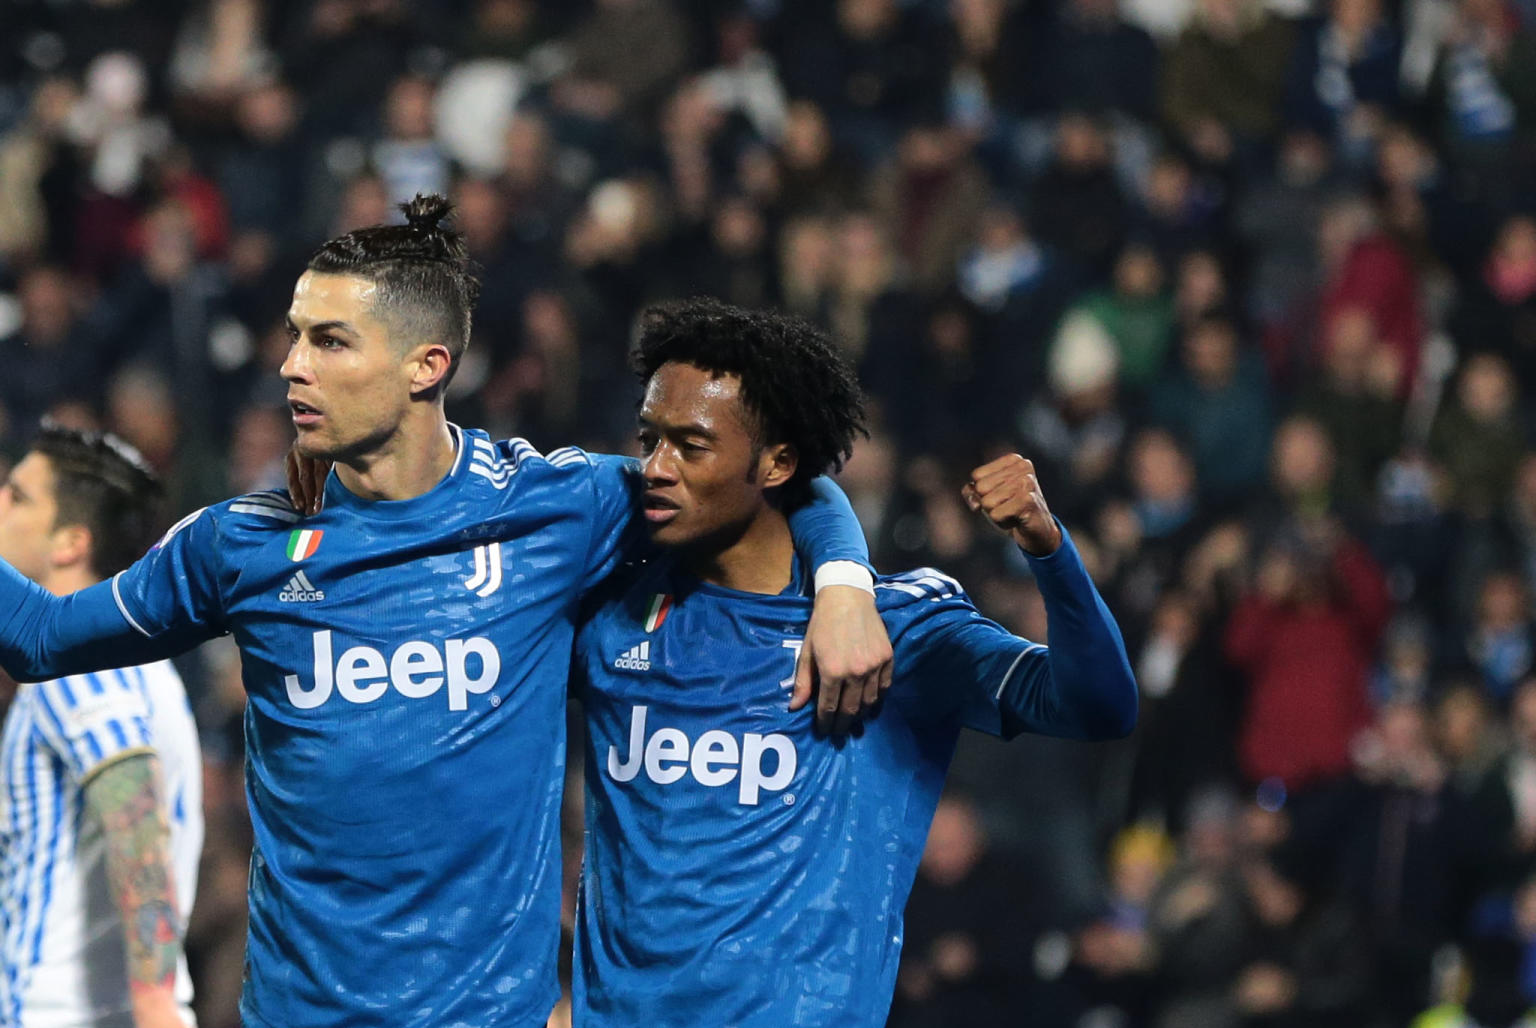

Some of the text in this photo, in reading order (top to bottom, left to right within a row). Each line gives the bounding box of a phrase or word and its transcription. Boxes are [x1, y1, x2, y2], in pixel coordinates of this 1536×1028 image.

[278, 589, 325, 602] adidas
[284, 629, 501, 712] Jeep
[614, 656, 651, 671] adidas
[607, 705, 797, 806] Jeep
